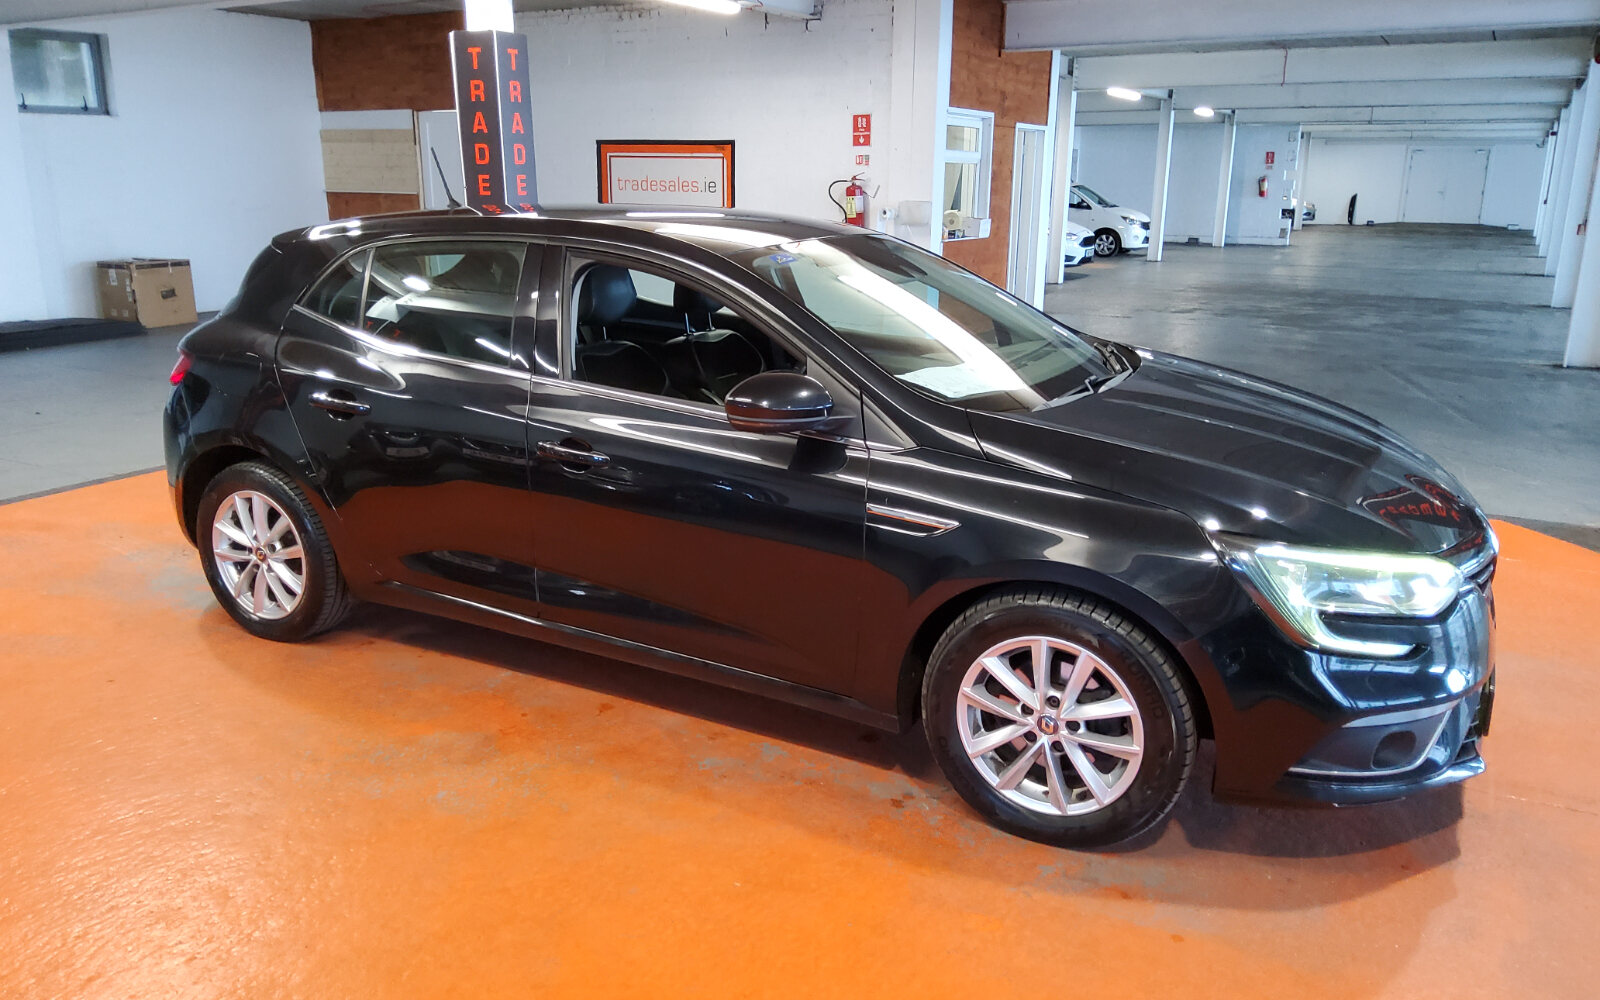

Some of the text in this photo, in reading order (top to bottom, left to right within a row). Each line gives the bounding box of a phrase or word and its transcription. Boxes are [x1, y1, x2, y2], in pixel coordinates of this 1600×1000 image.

[467, 47, 491, 196] TRADE
[507, 48, 528, 196] TRADE
[617, 175, 717, 193] tradesales.ie
